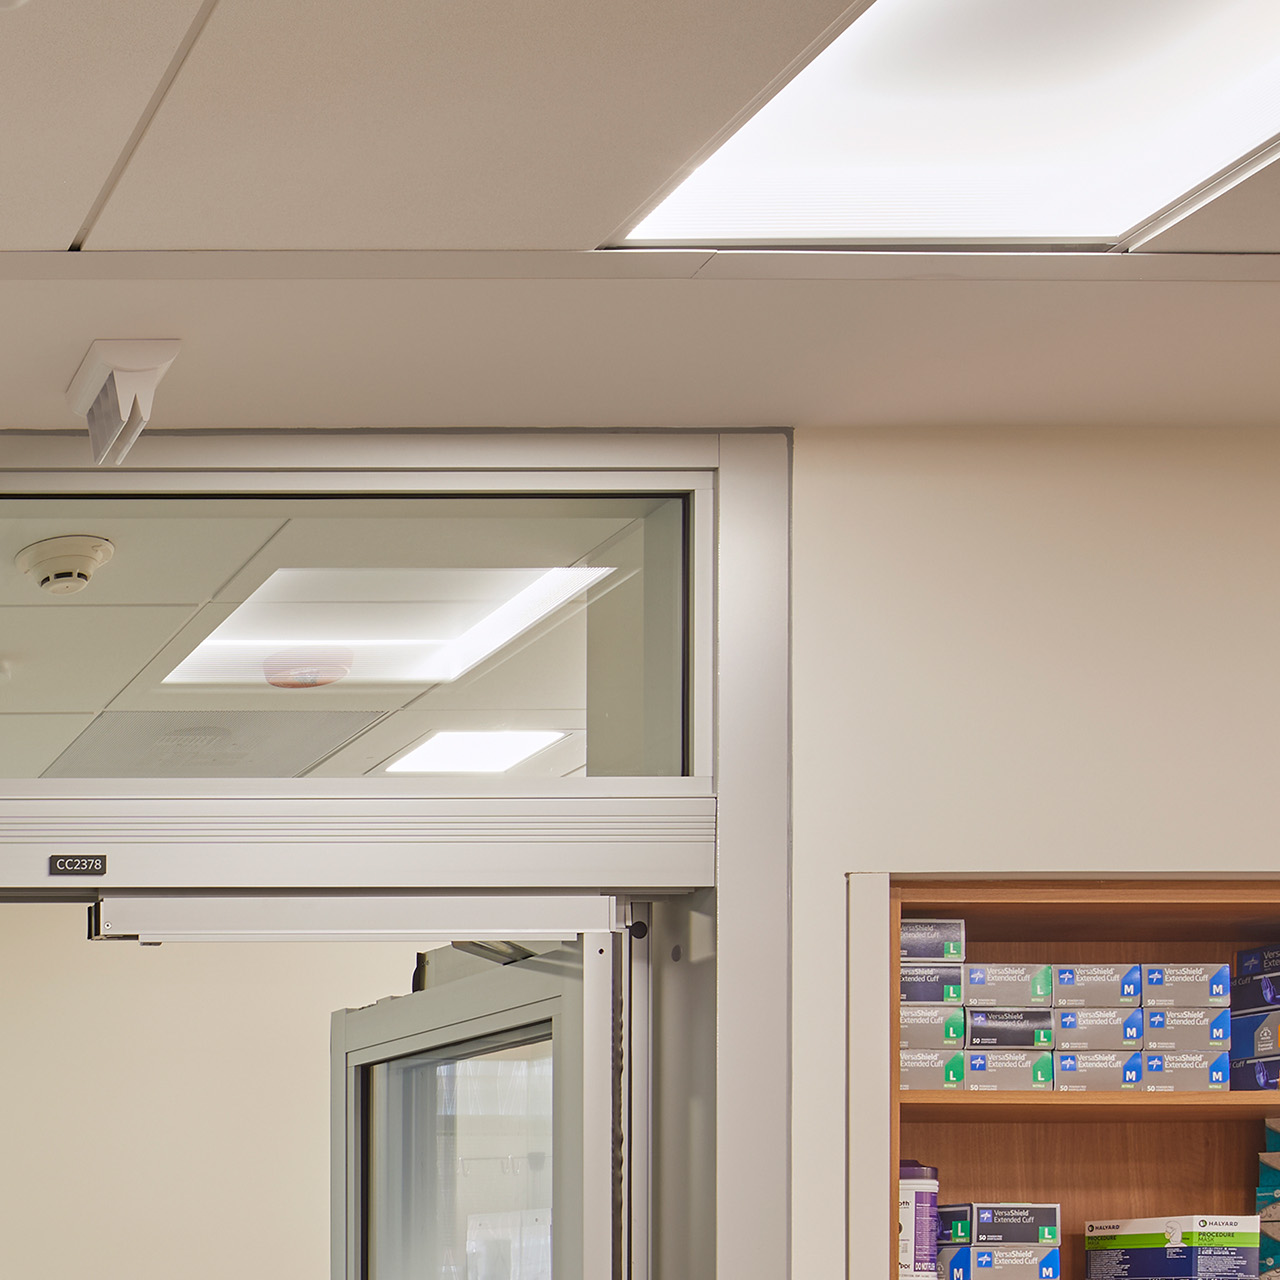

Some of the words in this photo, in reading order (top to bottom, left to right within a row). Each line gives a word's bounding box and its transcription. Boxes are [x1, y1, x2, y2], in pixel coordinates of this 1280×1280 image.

[56, 859, 102, 870] CC2378
[950, 943, 957, 953] L
[950, 986, 956, 997] L
[1037, 985, 1043, 995] L
[1124, 984, 1134, 995] M
[1212, 984, 1223, 995] M
[950, 1027, 956, 1037] L
[1040, 1031, 1047, 1041] L
[1126, 1027, 1136, 1037] M
[1213, 1028, 1223, 1038] M
[950, 1071, 956, 1081] L
[1038, 1071, 1045, 1081] L
[1126, 1071, 1136, 1081] M
[1212, 1071, 1223, 1081] M
[958, 1223, 964, 1236] L
[1044, 1228, 1052, 1238] L
[915, 1262, 922, 1270] DO
[953, 1268, 963, 1280] M
[1042, 1267, 1053, 1278] M
